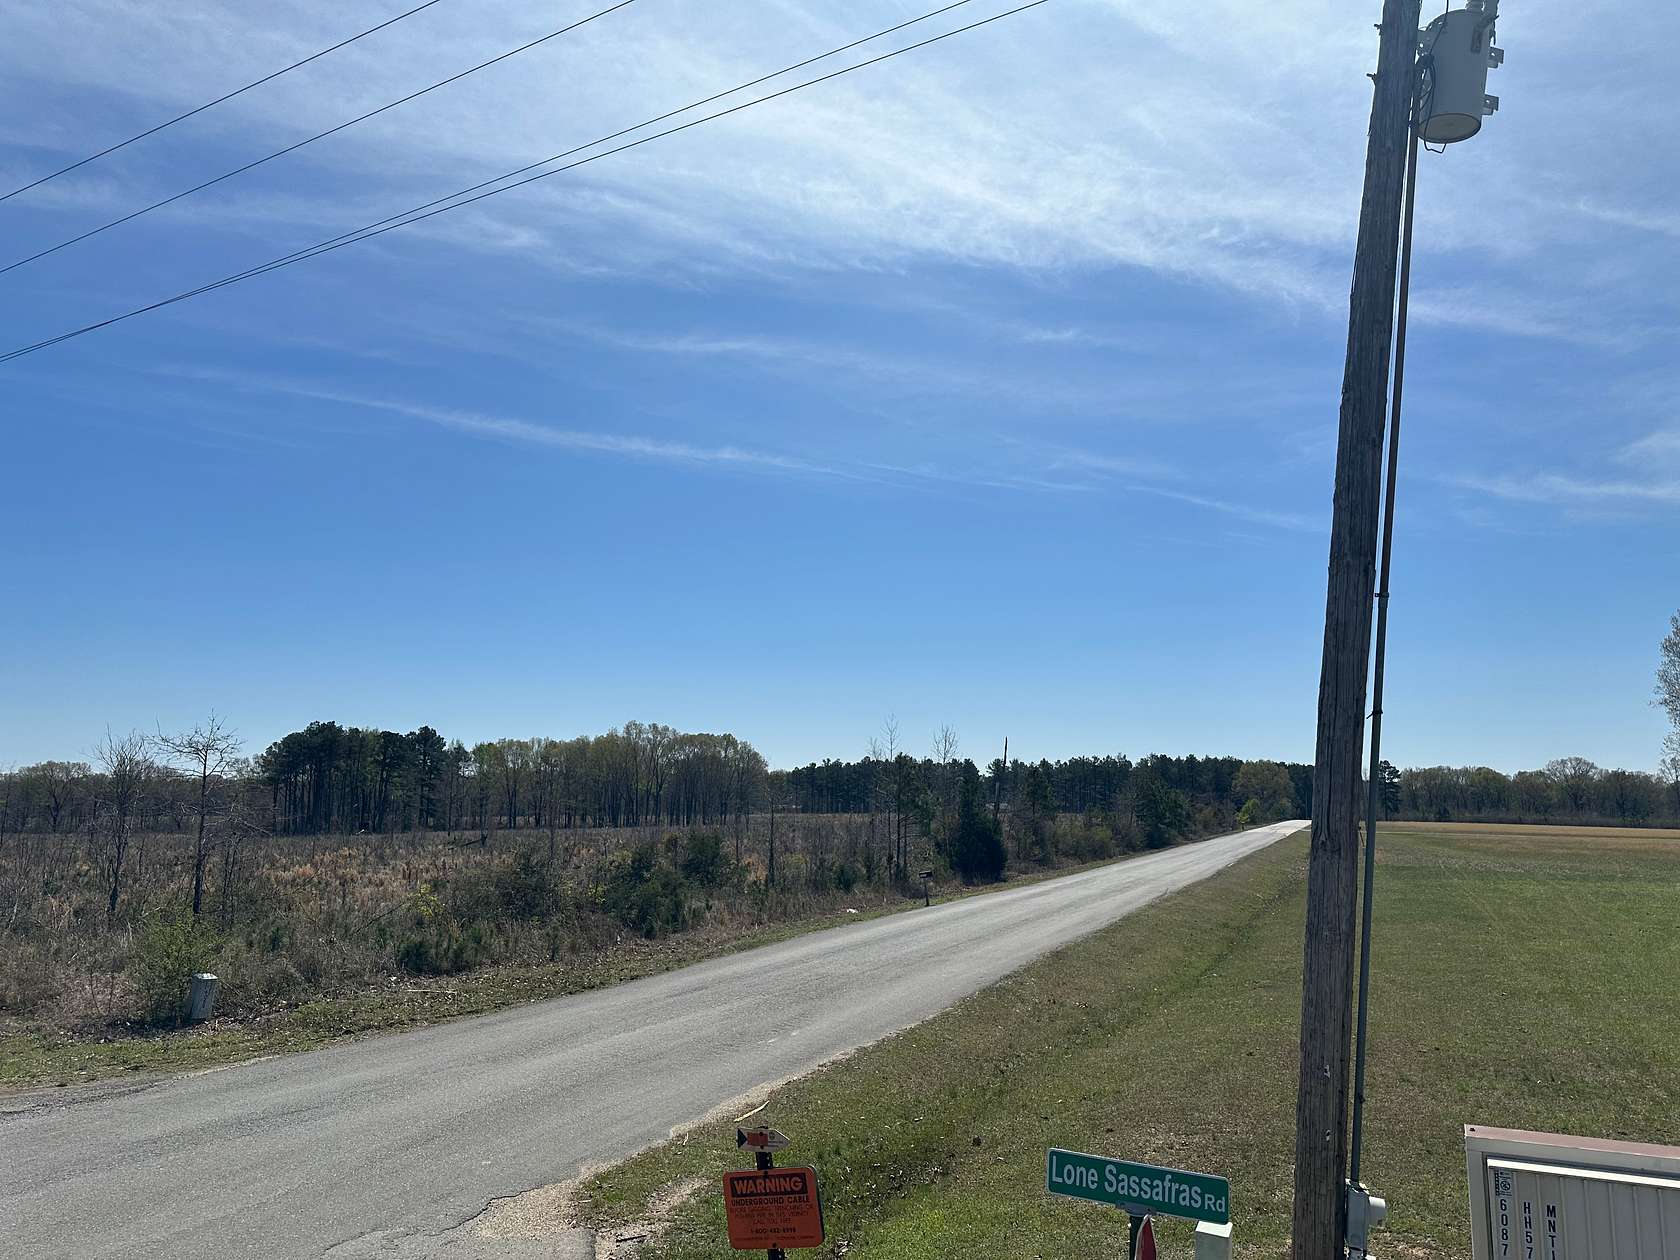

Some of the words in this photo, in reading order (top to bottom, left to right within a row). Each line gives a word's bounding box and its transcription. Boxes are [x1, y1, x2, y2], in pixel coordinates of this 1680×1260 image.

[731, 1197, 784, 1207] UNDERGROUND
[787, 1195, 809, 1204] CABLE
[734, 1176, 803, 1195] WARNING
[1051, 1155, 1098, 1189] Lone
[1104, 1164, 1202, 1208] Sassafras
[1204, 1193, 1226, 1213] Rd
[1499, 1198, 1509, 1256] 6087
[1523, 1201, 1533, 1260] HH57
